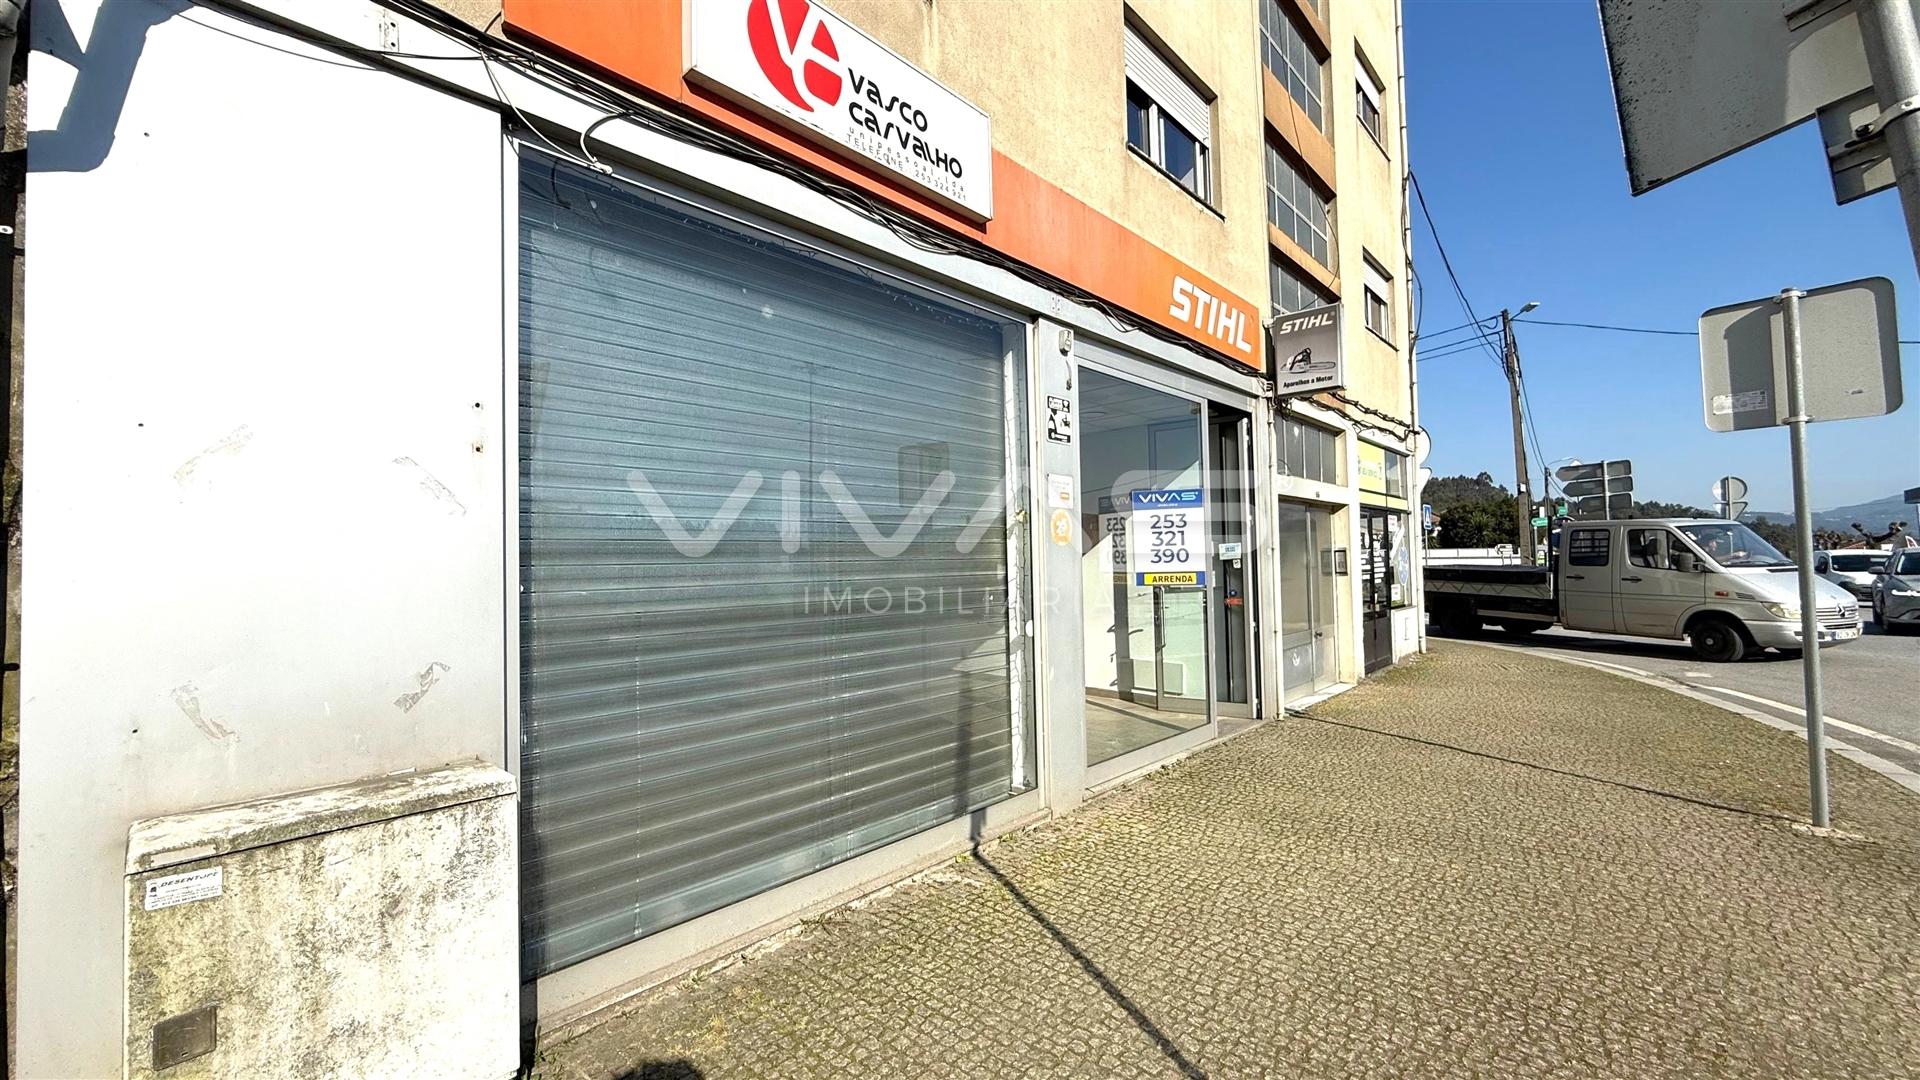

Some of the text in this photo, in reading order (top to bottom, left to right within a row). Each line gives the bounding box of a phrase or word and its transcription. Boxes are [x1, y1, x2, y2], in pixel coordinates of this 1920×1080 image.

[1169, 275, 1252, 353] STIHL
[1280, 313, 1334, 335] STIHL
[1315, 375, 1334, 383] Motor
[1138, 491, 1195, 504] VIVAS
[1150, 513, 1187, 530] 253
[1151, 530, 1186, 547] 321
[1150, 548, 1190, 564] 390
[1151, 573, 1193, 584] ARRENDA
